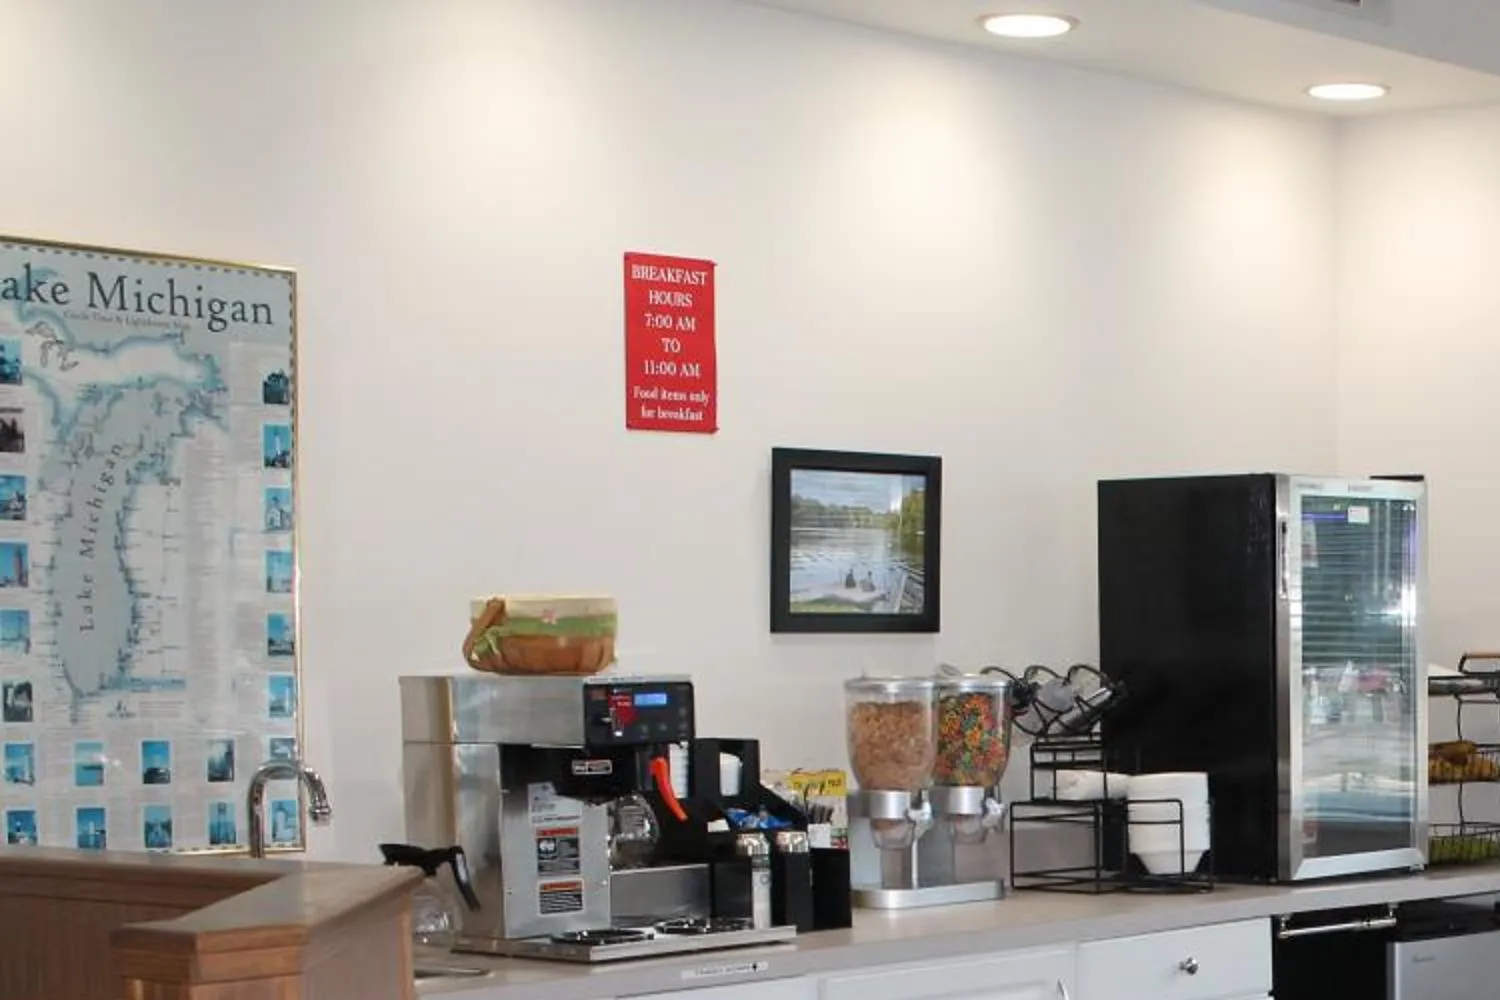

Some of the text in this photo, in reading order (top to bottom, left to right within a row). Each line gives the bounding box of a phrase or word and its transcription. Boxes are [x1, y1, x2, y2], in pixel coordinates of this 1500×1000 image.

[631, 264, 708, 285] BREAKFAST
[0, 262, 274, 333] ake Michigan
[648, 290, 694, 308] HOURS
[644, 313, 697, 333] 7:00 AM
[661, 337, 682, 353] TO
[643, 359, 701, 379] 11:00 AM
[633, 385, 658, 399] Food
